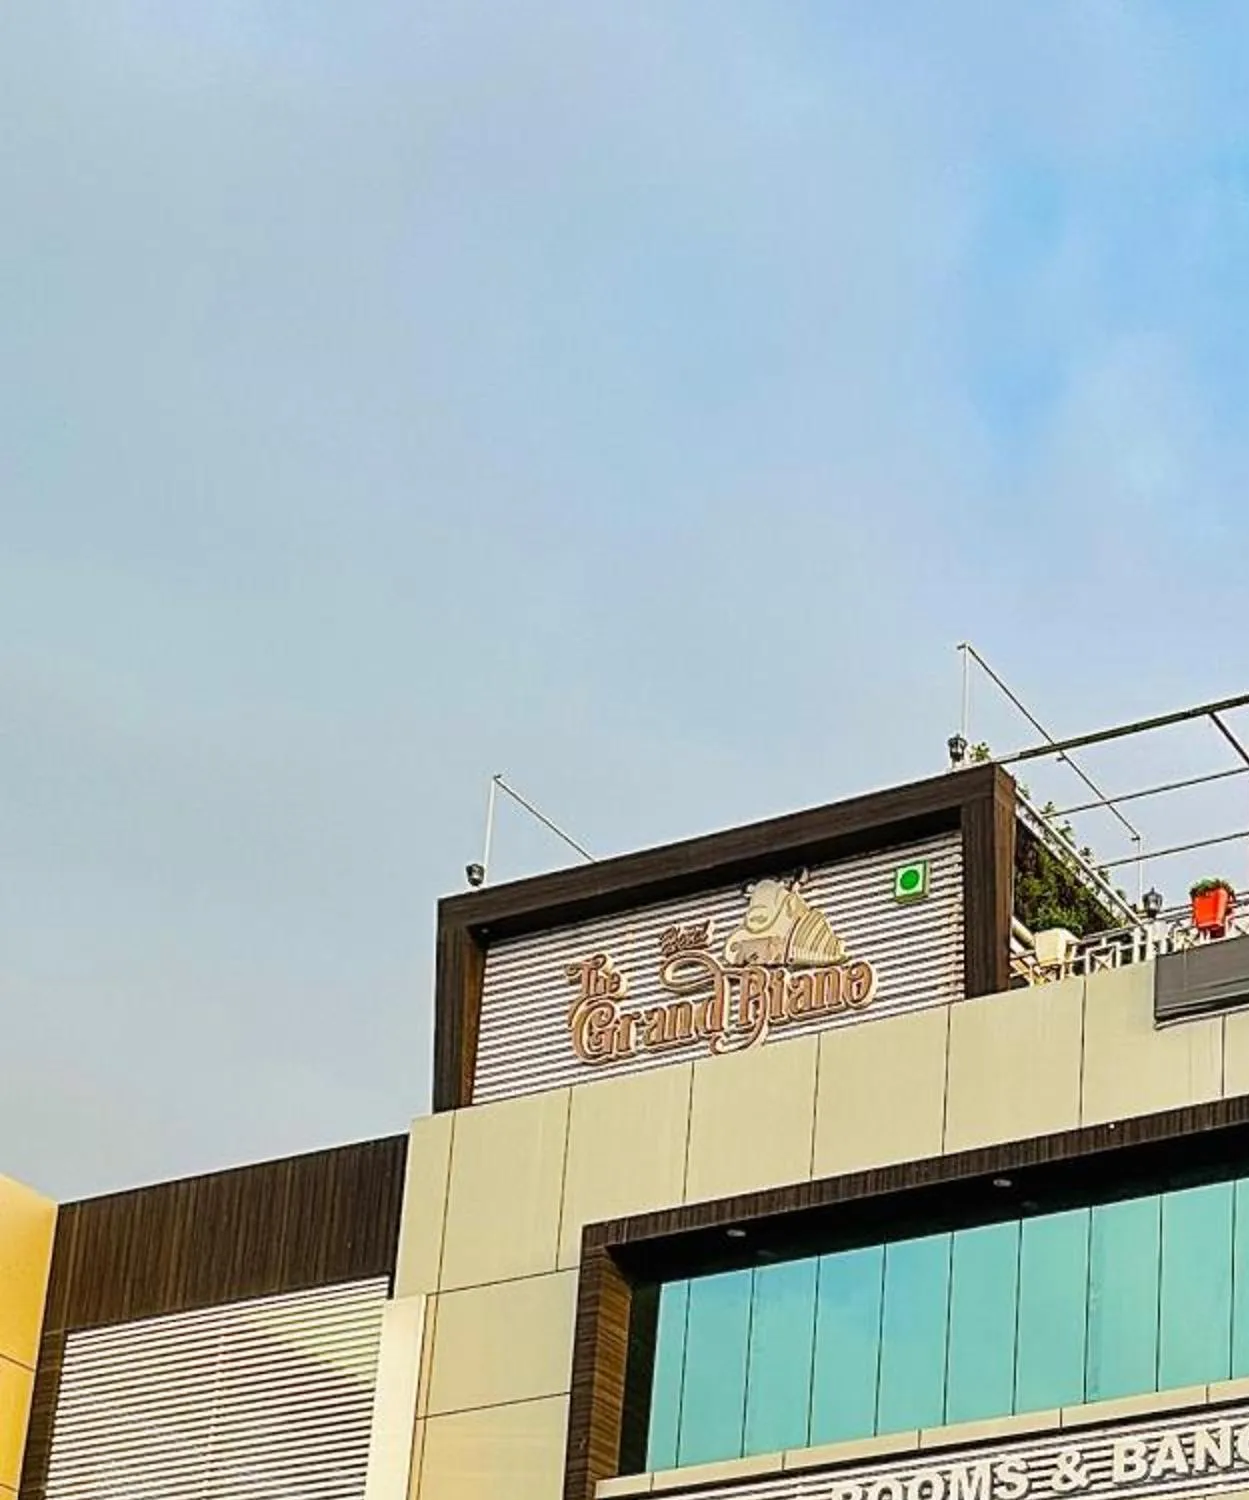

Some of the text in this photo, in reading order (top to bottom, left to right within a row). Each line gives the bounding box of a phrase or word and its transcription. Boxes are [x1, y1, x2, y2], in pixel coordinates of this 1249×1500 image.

[565, 954, 622, 997] The
[569, 949, 876, 1064] Grand Piano
[1052, 1450, 1091, 1493] &
